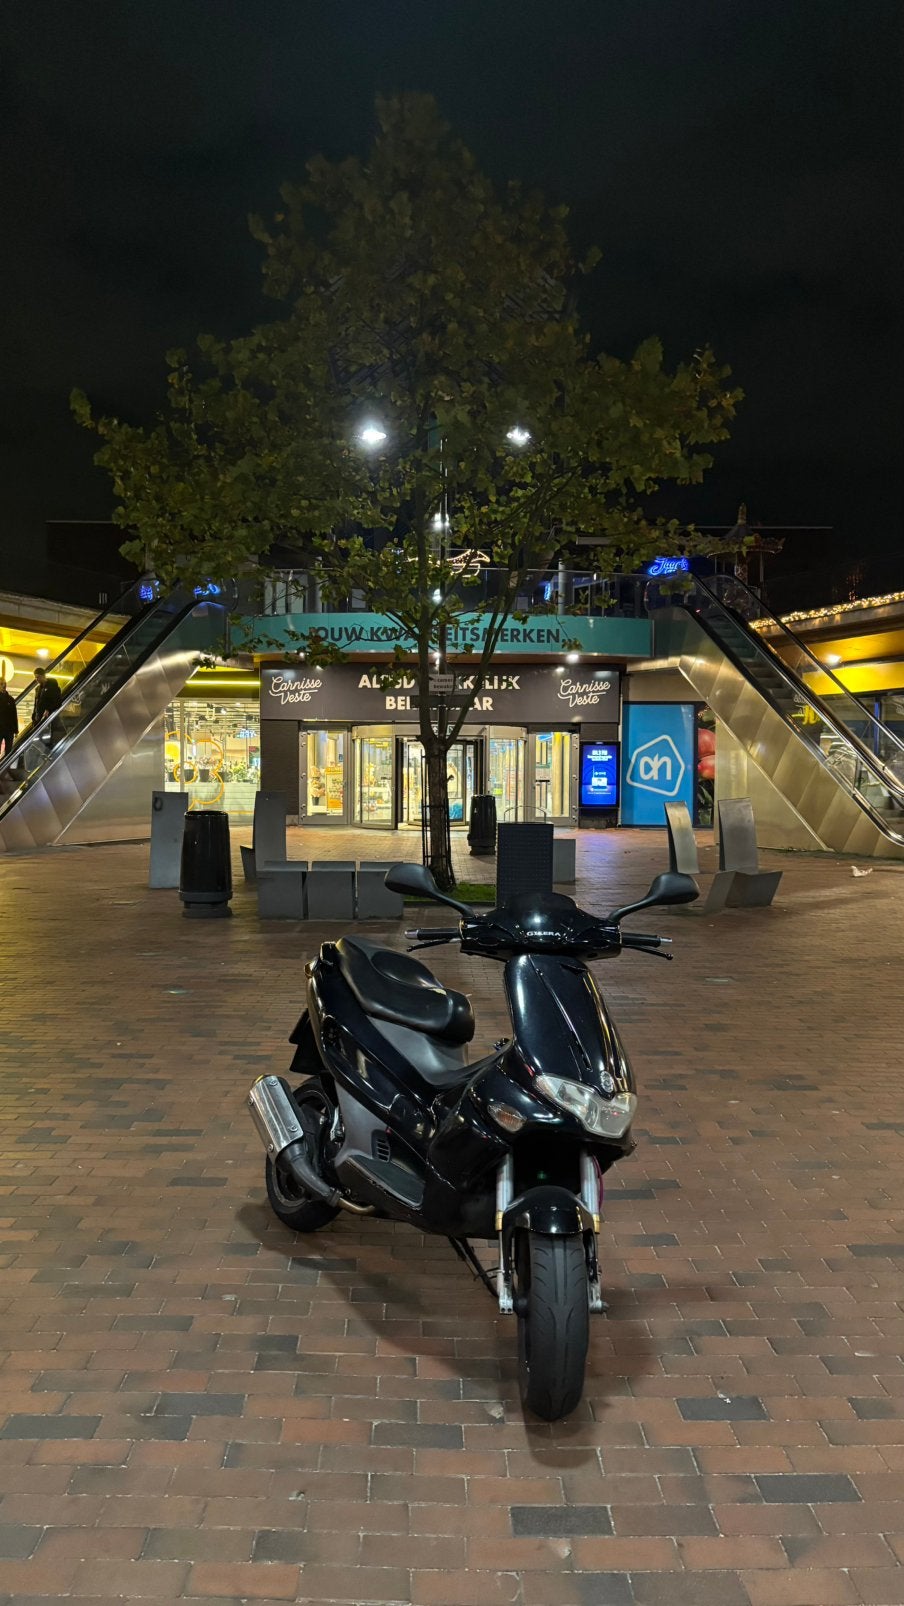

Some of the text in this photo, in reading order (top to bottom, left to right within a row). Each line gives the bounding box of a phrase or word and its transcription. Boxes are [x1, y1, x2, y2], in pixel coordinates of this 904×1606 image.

[271, 676, 323, 692] Carnisse
[560, 679, 611, 695] Carnisse
[269, 690, 318, 705] Veste
[557, 692, 607, 708] Veste
